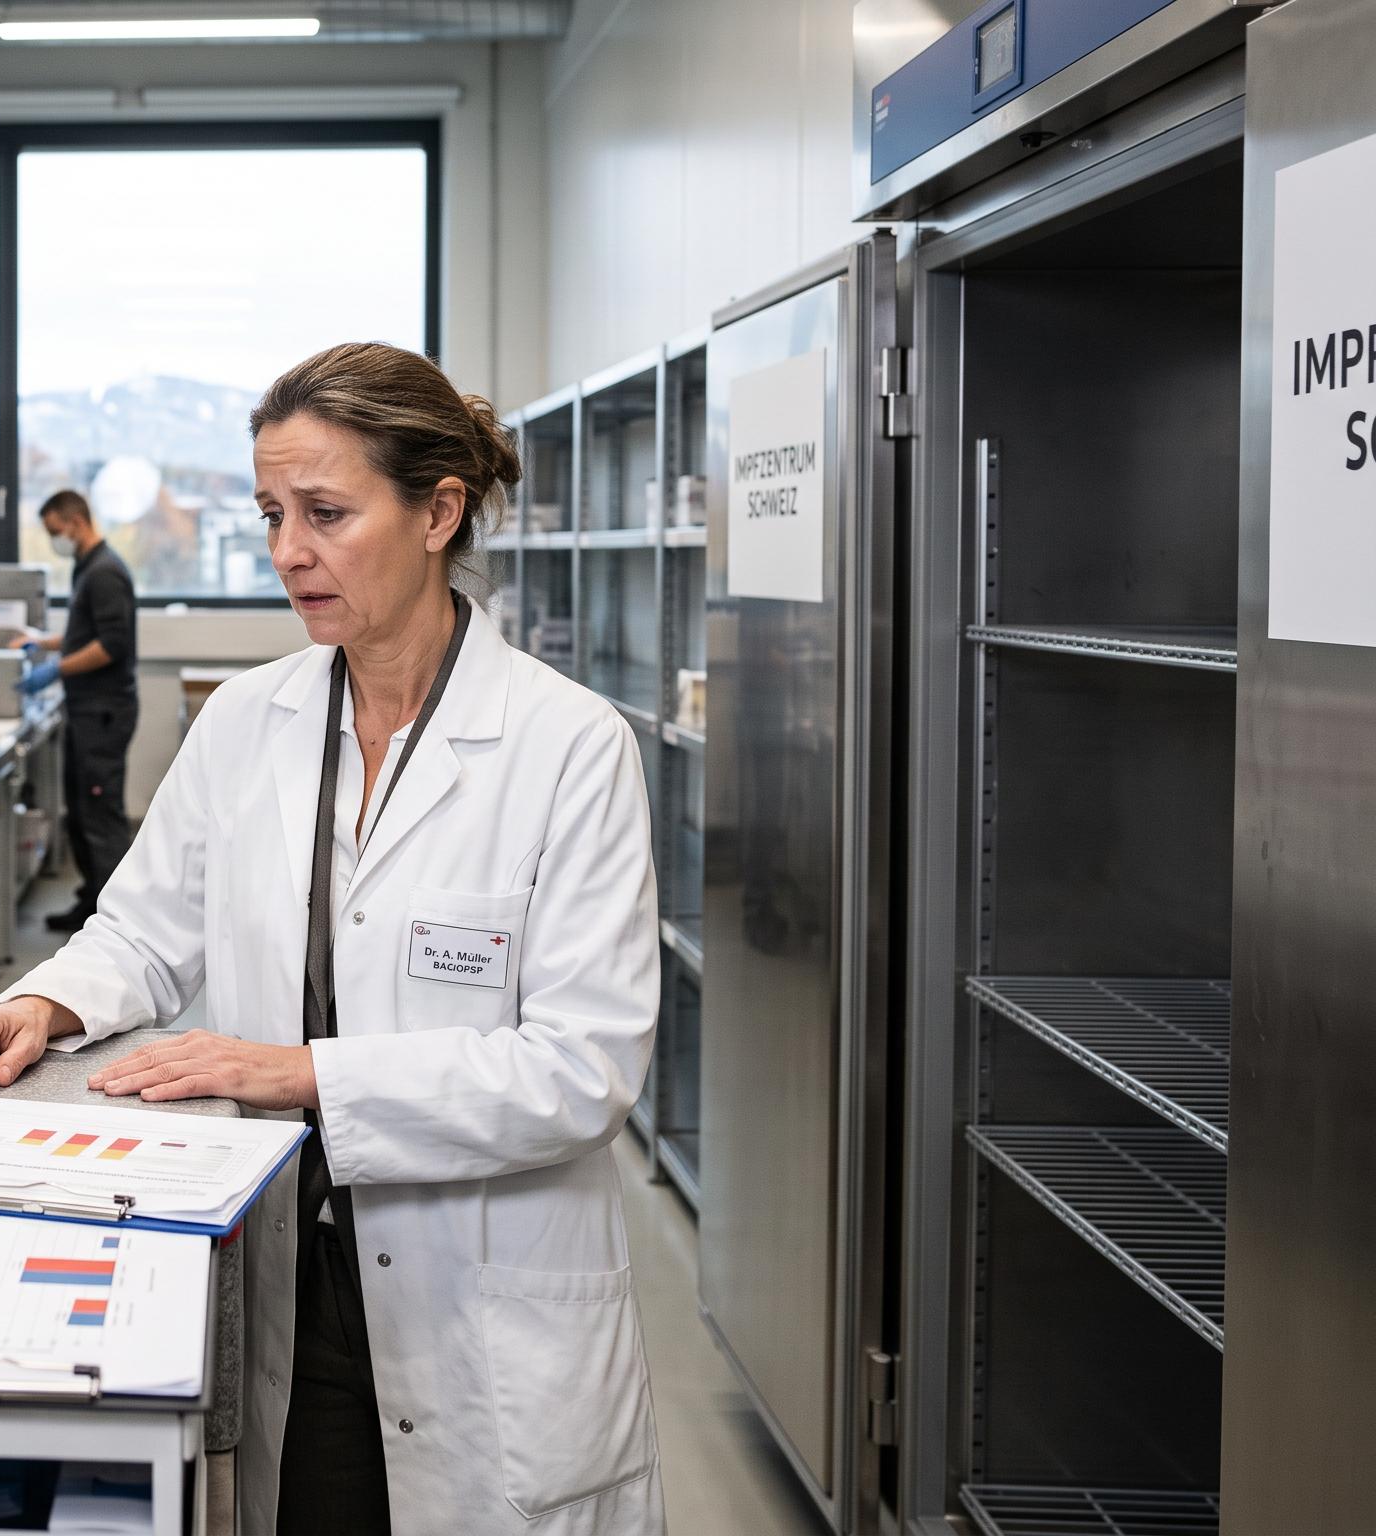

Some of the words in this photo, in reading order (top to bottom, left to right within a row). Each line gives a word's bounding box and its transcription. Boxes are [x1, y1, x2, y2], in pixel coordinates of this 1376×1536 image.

[1346, 410, 1376, 471] S
[735, 441, 816, 483] IMPFZENTRUM
[747, 486, 797, 518] SCHWEIZ
[424, 946, 439, 958] Dr.
[442, 949, 454, 960] A.
[457, 951, 492, 964] Müller
